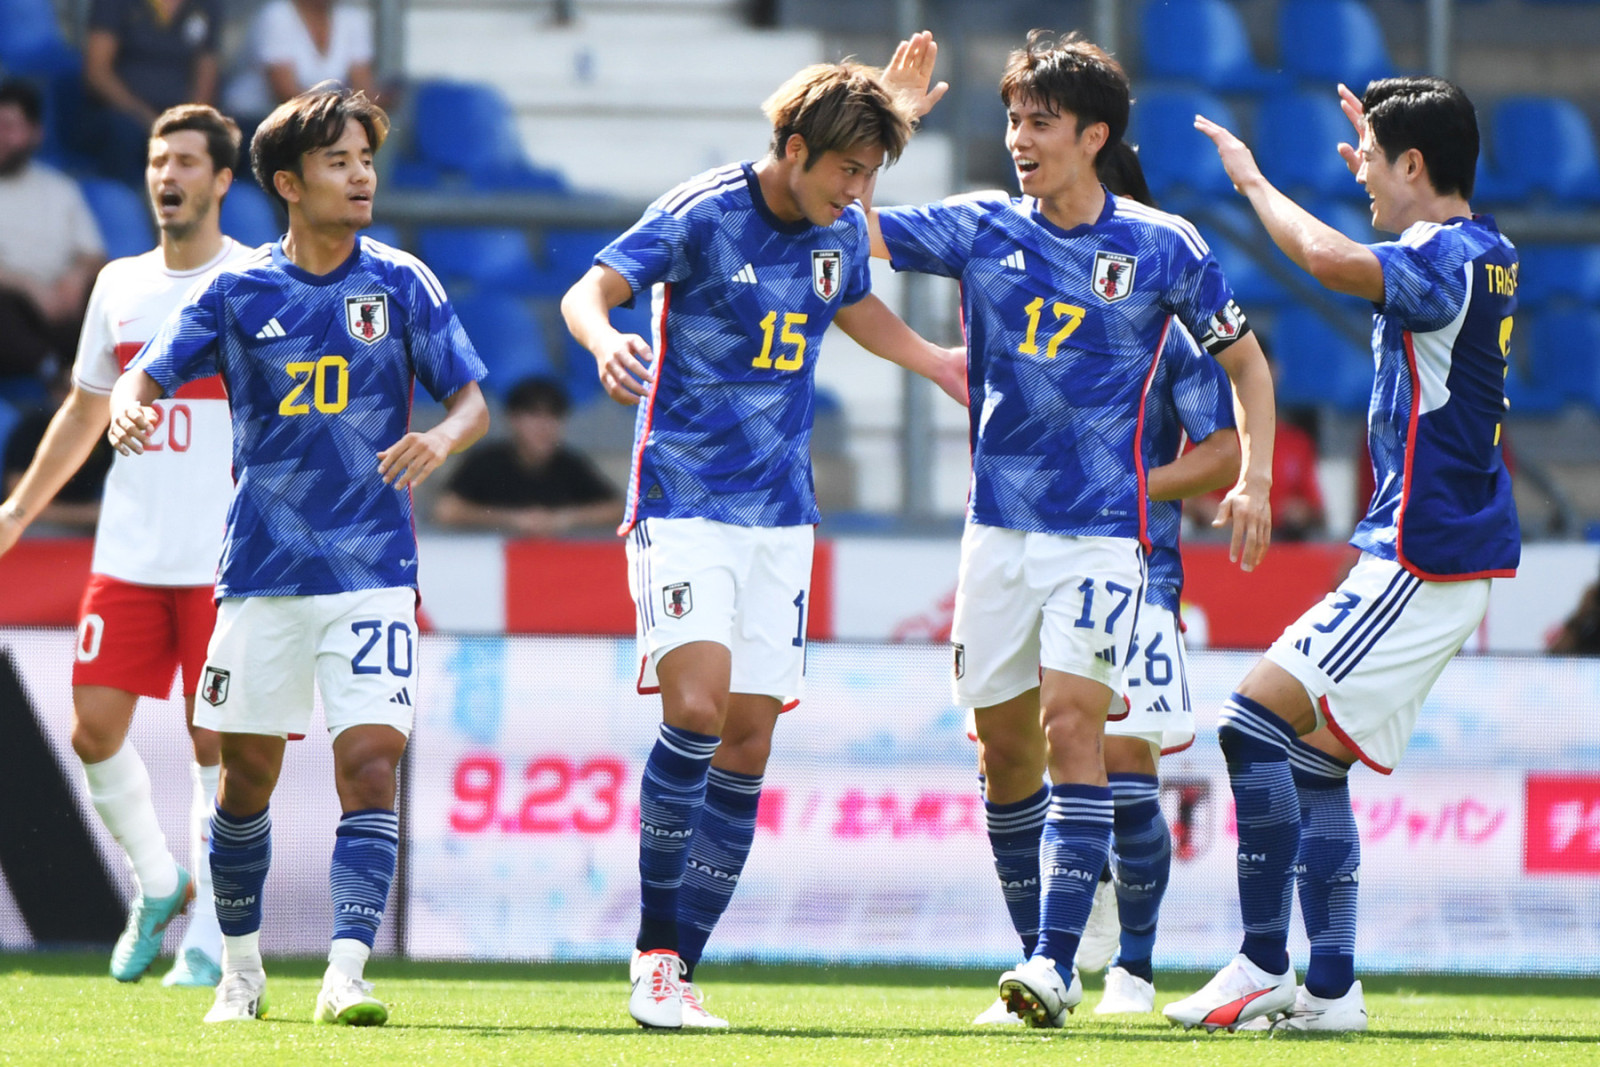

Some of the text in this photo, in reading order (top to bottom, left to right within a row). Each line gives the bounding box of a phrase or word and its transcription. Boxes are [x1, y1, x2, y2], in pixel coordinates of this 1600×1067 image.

[751, 310, 808, 371] 15
[1018, 297, 1086, 358] 17
[278, 355, 349, 416] 20
[1074, 577, 1133, 635] 17
[1312, 589, 1362, 634] 3
[351, 619, 413, 678] 20
[448, 754, 628, 835] 9.23
[687, 859, 739, 882] JAPA
[340, 903, 384, 920] JAPA
